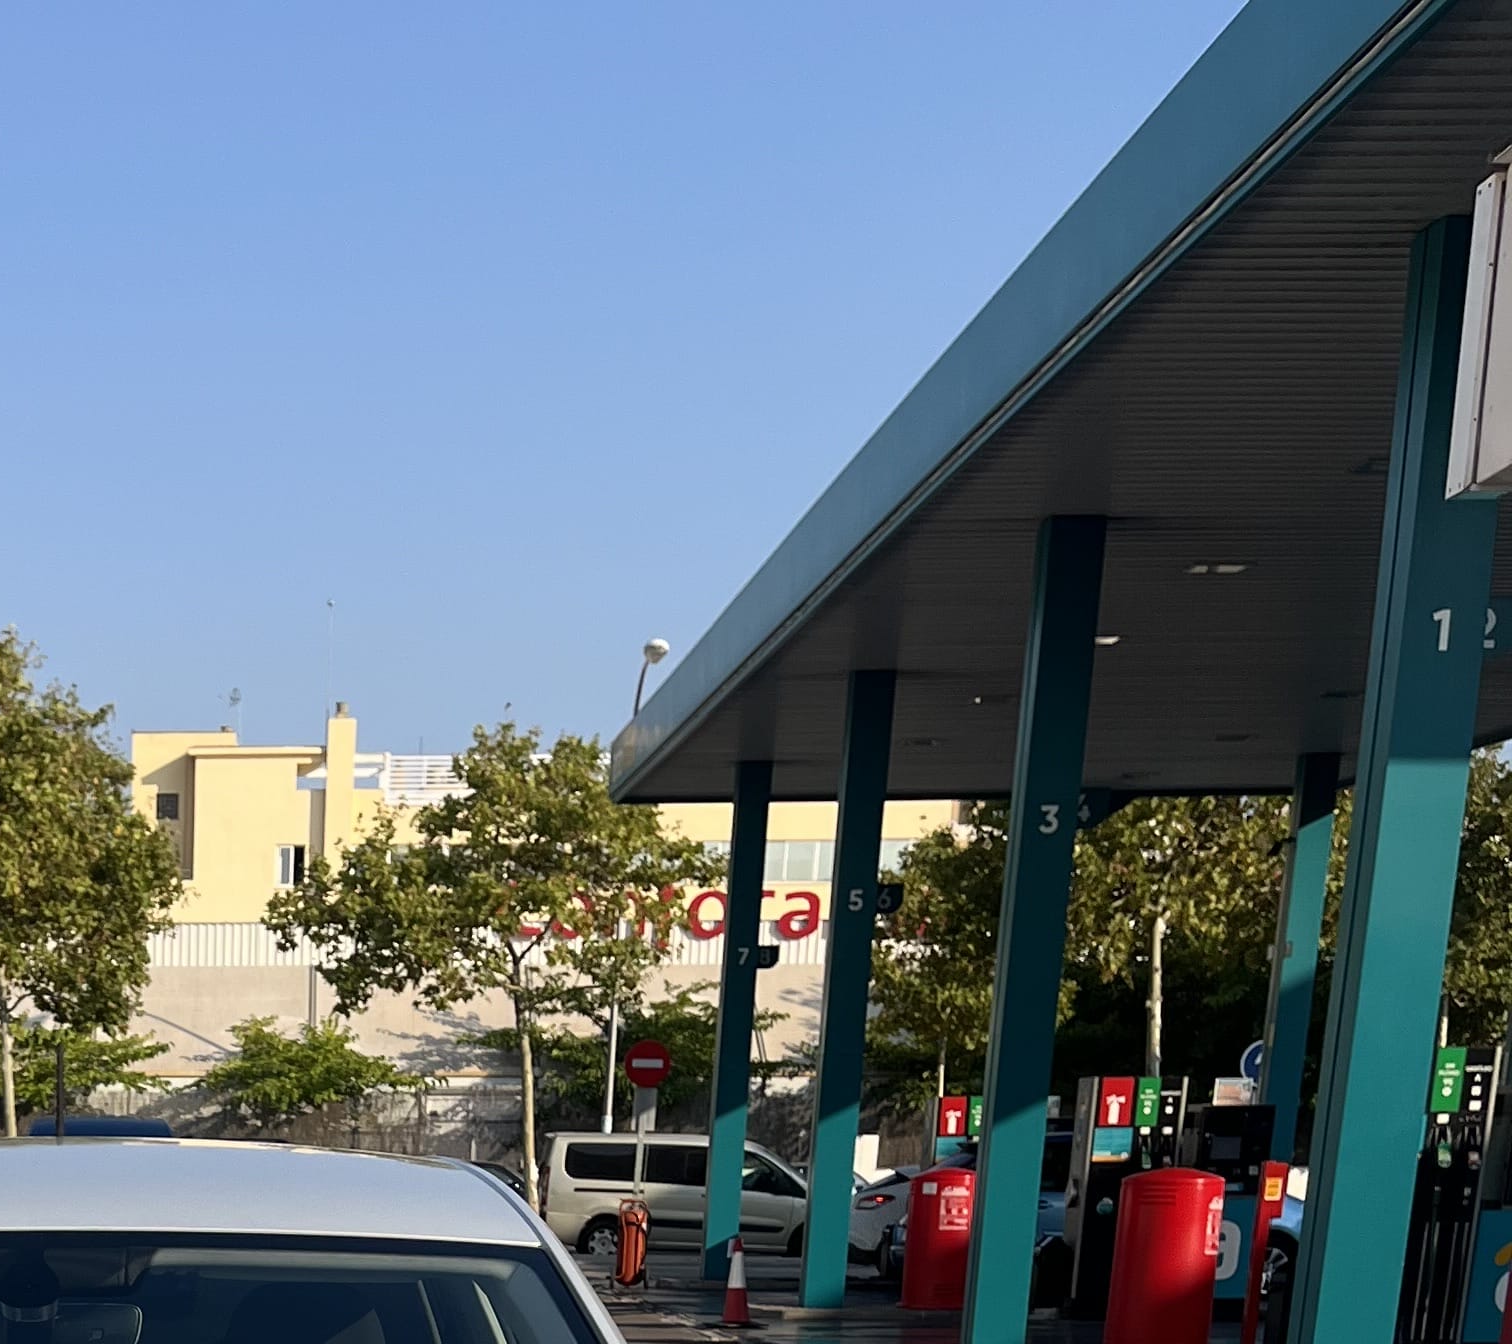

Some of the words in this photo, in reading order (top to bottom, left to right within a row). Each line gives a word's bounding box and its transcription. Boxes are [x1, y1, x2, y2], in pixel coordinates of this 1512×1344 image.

[1431, 608, 1452, 652] 1
[1038, 804, 1060, 835] 3
[847, 888, 865, 912] 5
[877, 889, 890, 910] 6
[737, 947, 750, 966] 7
[759, 948, 771, 965] 8
